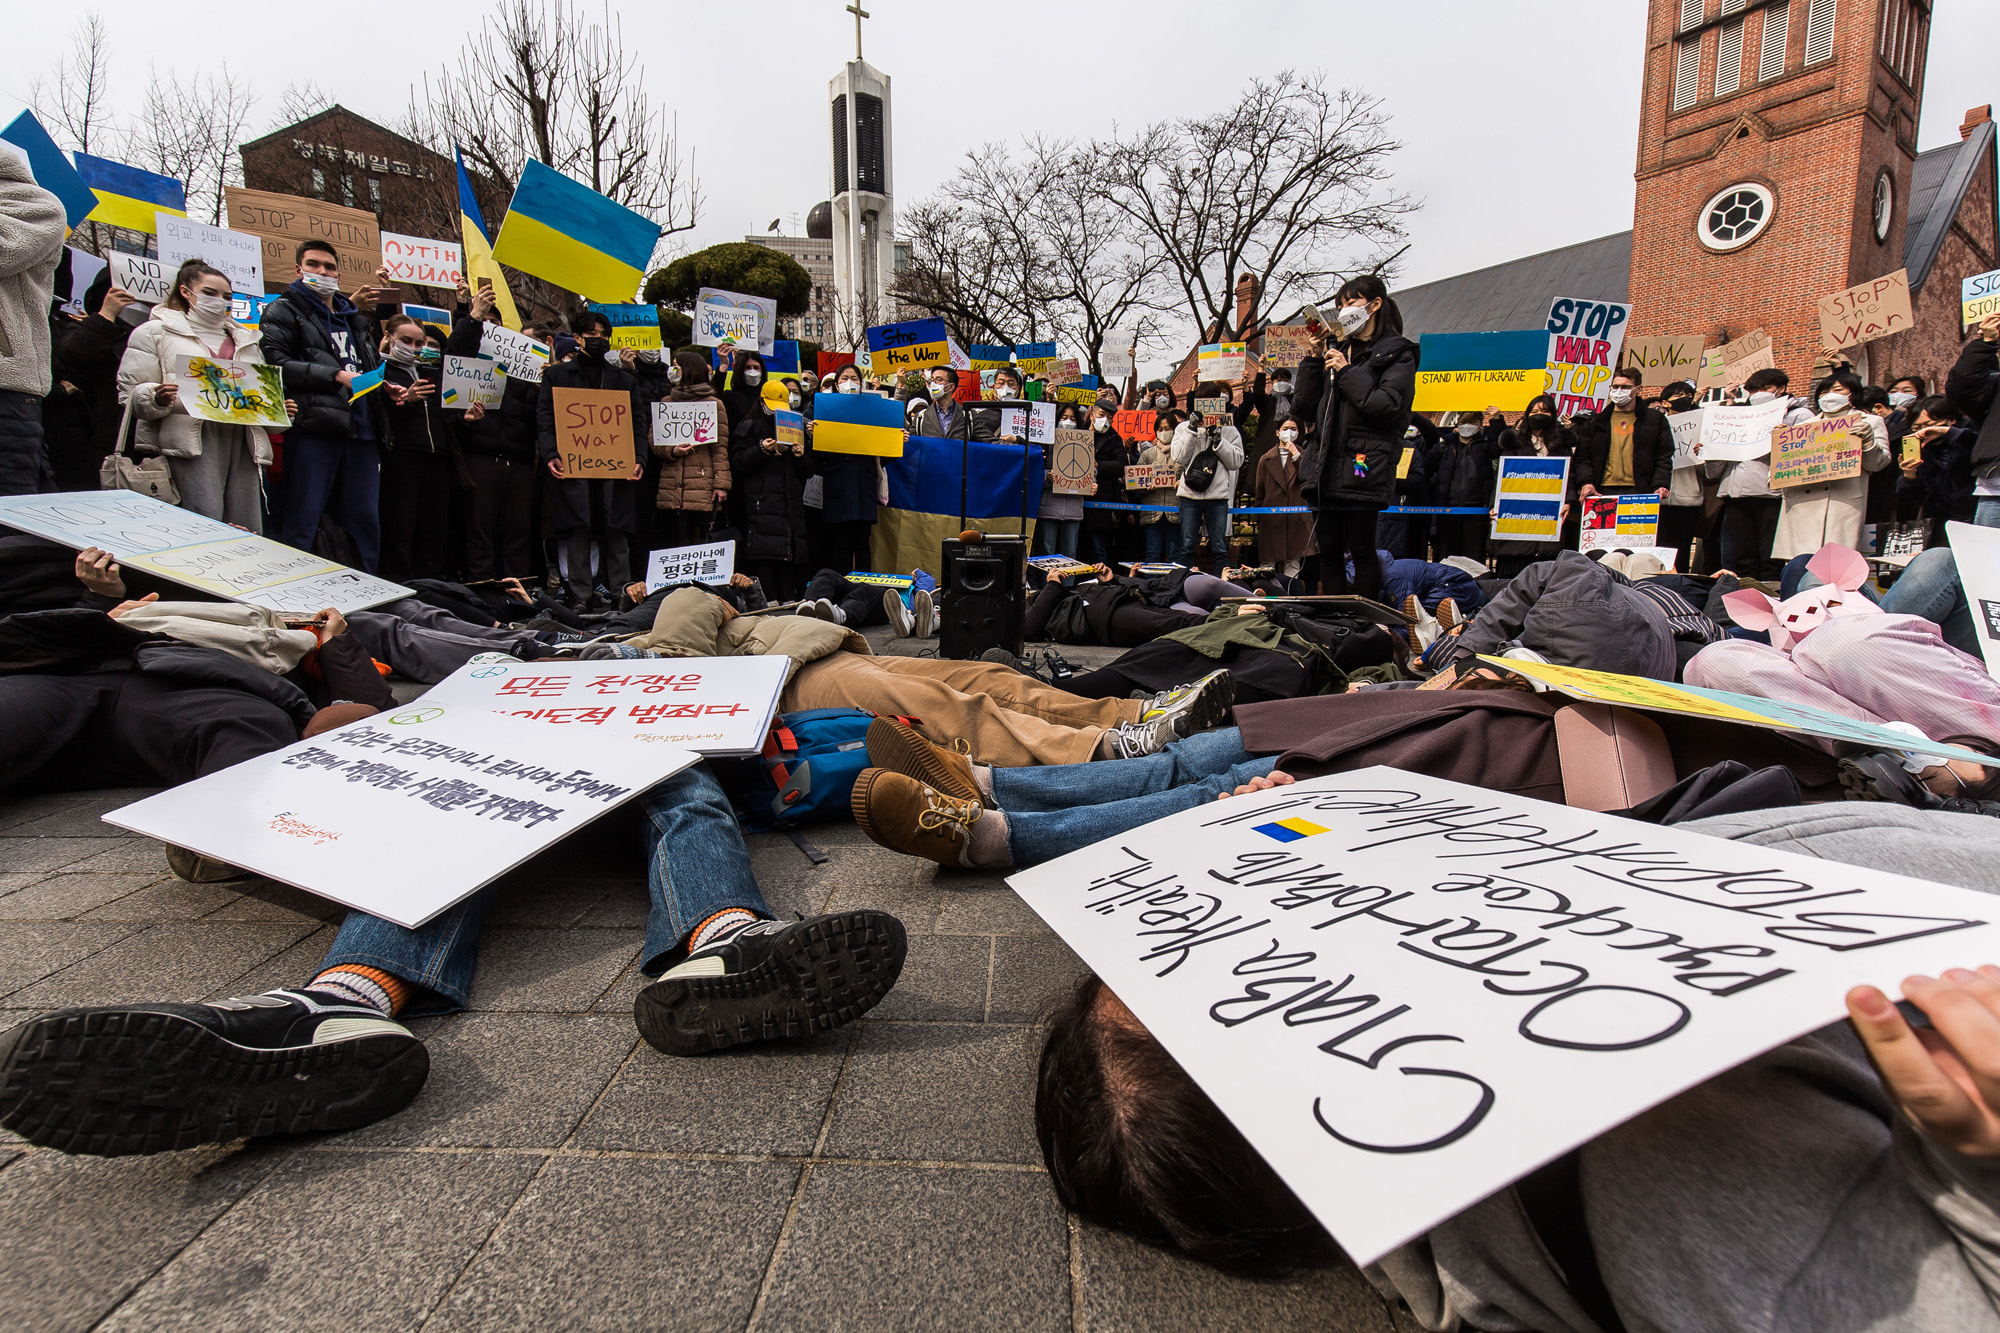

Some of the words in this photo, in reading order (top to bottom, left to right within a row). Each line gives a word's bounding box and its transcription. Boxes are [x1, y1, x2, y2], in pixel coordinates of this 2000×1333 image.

[239, 205, 296, 229] STOP
[309, 215, 371, 247] PUTIN
[166, 222, 194, 240] 외교
[201, 230, 223, 246] 실패
[229, 239, 256, 252] 아니라
[261, 240, 287, 258] TOP
[127, 258, 161, 278] NO
[386, 259, 460, 284] ХУЙЛО
[120, 273, 170, 298] WAR
[1548, 299, 1626, 340] STOP
[1839, 304, 1880, 324] the
[882, 328, 917, 347] Stop
[1267, 327, 1284, 337] NO
[979, 347, 1000, 358] NO
[1022, 344, 1052, 358] НЕТ
[1267, 340, 1297, 352] 전쟁을
[1555, 336, 1611, 366] WAR
[1725, 330, 1766, 361] STOP
[887, 350, 911, 365] the
[914, 347, 941, 362] War
[1728, 360, 1743, 369] THE
[447, 358, 494, 382] Stand
[1422, 373, 1451, 384] STAND
[1456, 372, 1481, 383] WITH
[1484, 371, 1526, 382] UKRAINE
[1058, 389, 1097, 405] ВОЙНЕ
[1196, 399, 1225, 413] PEACE
[1551, 393, 1605, 416] UTIN
[566, 402, 626, 429] STOP
[658, 402, 710, 421] Russia
[661, 421, 701, 439] STOP
[1117, 411, 1154, 435] PEACE
[1055, 431, 1095, 453] DIALOGUE
[1779, 424, 1812, 445] STOP
[1781, 440, 1806, 452] STOP
[1816, 431, 1846, 444] PUTIN
[567, 453, 627, 474] Please
[1128, 467, 1153, 477] STOP
[1055, 474, 1074, 490] NOT
[1076, 473, 1095, 489] WAR
[1155, 476, 1175, 486] OUT
[1506, 472, 1560, 480] #StandWithUkraine
[3, 506, 106, 530] NO
[1501, 512, 1556, 521] #StandWithUkraine
[83, 531, 172, 554] NO
[658, 547, 726, 564] 우크라이나에
[662, 559, 719, 579] 평화를
[495, 675, 573, 698] 모든
[585, 674, 702, 695] 전쟁은
[628, 703, 750, 725] 범죄다
[331, 725, 394, 756] 우리는
[492, 758, 560, 788] 러시아
[550, 768, 633, 803] 등지에서
[281, 746, 344, 771] 전쟁에
[341, 758, 414, 790] 저항하는
[403, 776, 488, 812] 사람들을
[465, 793, 566, 829] 지지한다
[1210, 938, 1496, 1153] Слава
